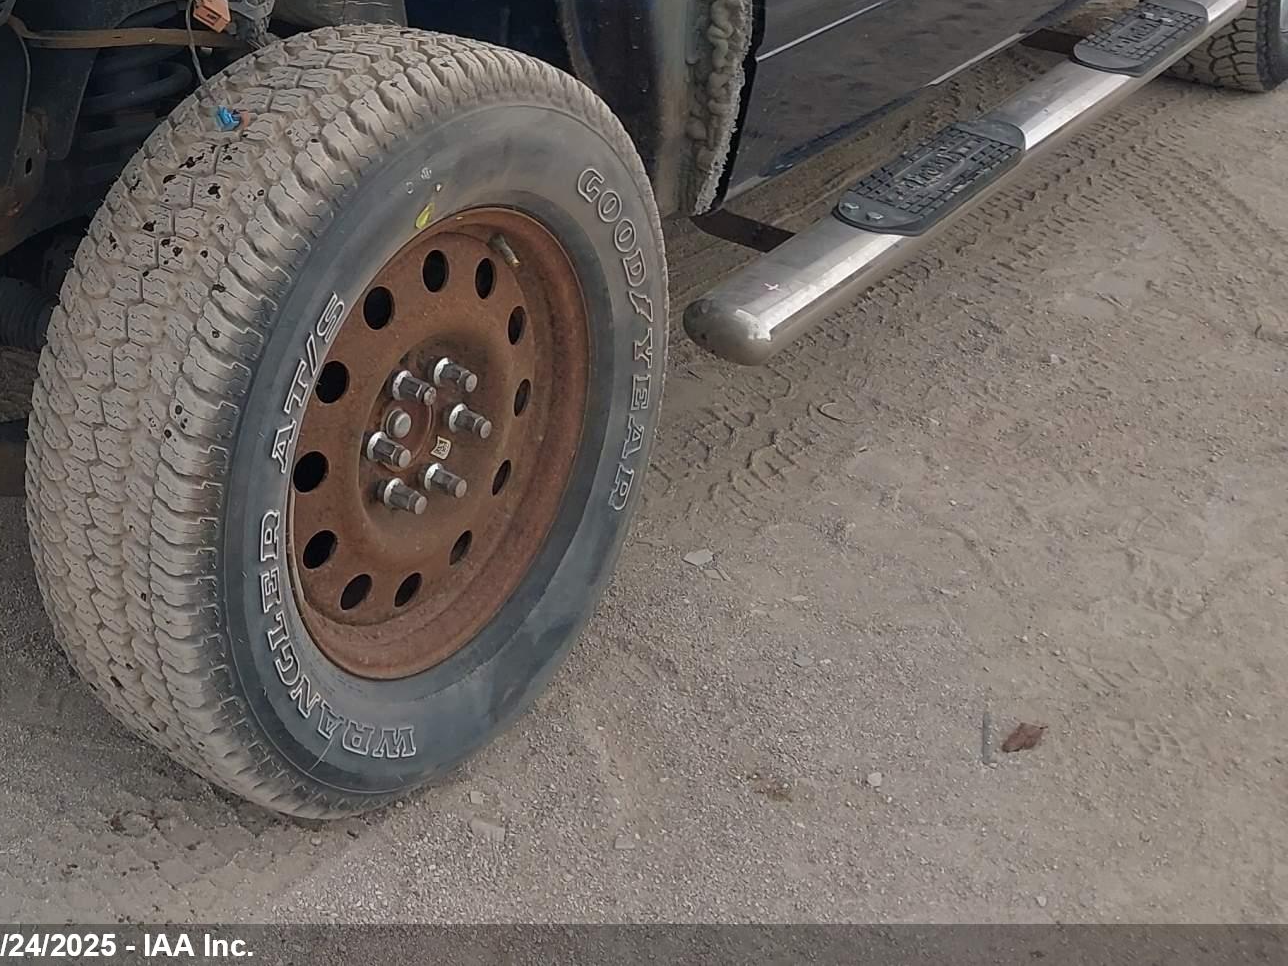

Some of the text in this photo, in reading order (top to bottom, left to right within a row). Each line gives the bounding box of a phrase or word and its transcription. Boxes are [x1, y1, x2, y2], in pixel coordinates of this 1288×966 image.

[260, 291, 417, 760] WRANGLER AT/S
[578, 168, 654, 512] GOODYEAR
